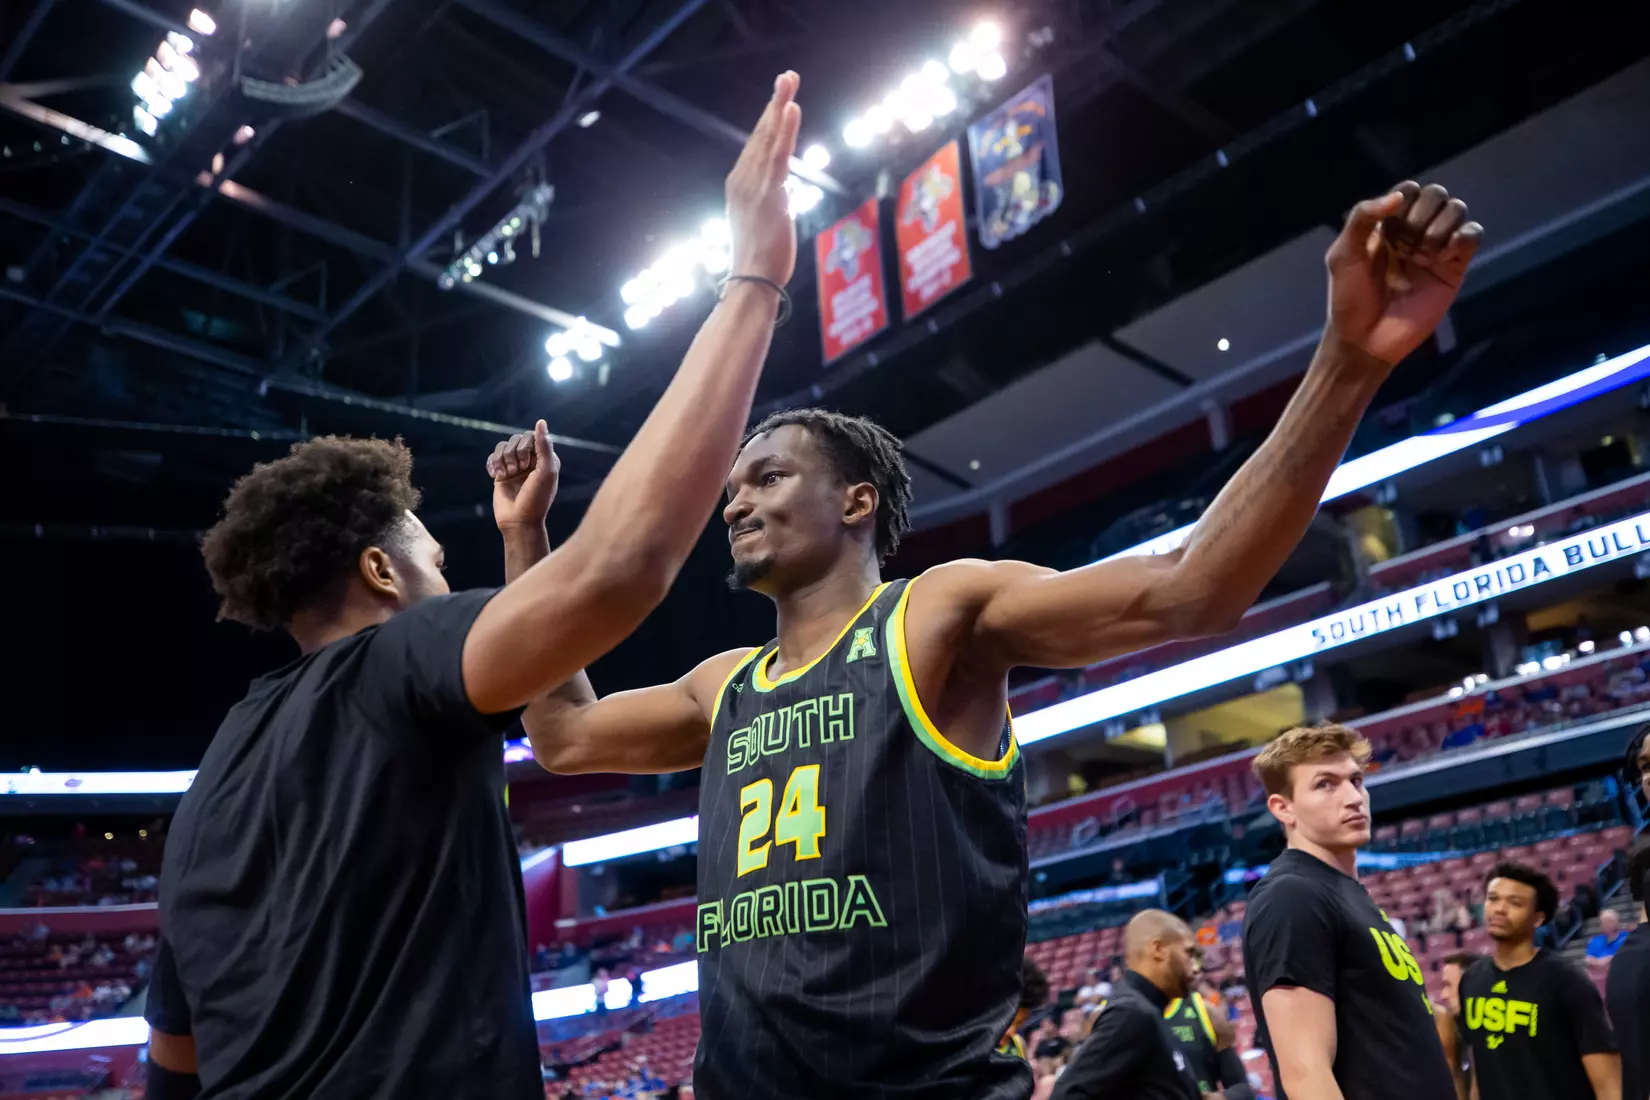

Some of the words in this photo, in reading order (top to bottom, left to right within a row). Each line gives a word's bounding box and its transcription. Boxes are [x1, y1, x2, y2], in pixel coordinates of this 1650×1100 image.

[1312, 600, 1404, 645] SOUTH
[1414, 556, 1552, 618] FLORIDA
[727, 693, 855, 775] SOUTH
[738, 764, 826, 877] 24
[697, 875, 888, 954] FLORIDA
[1465, 997, 1530, 1034] USF
